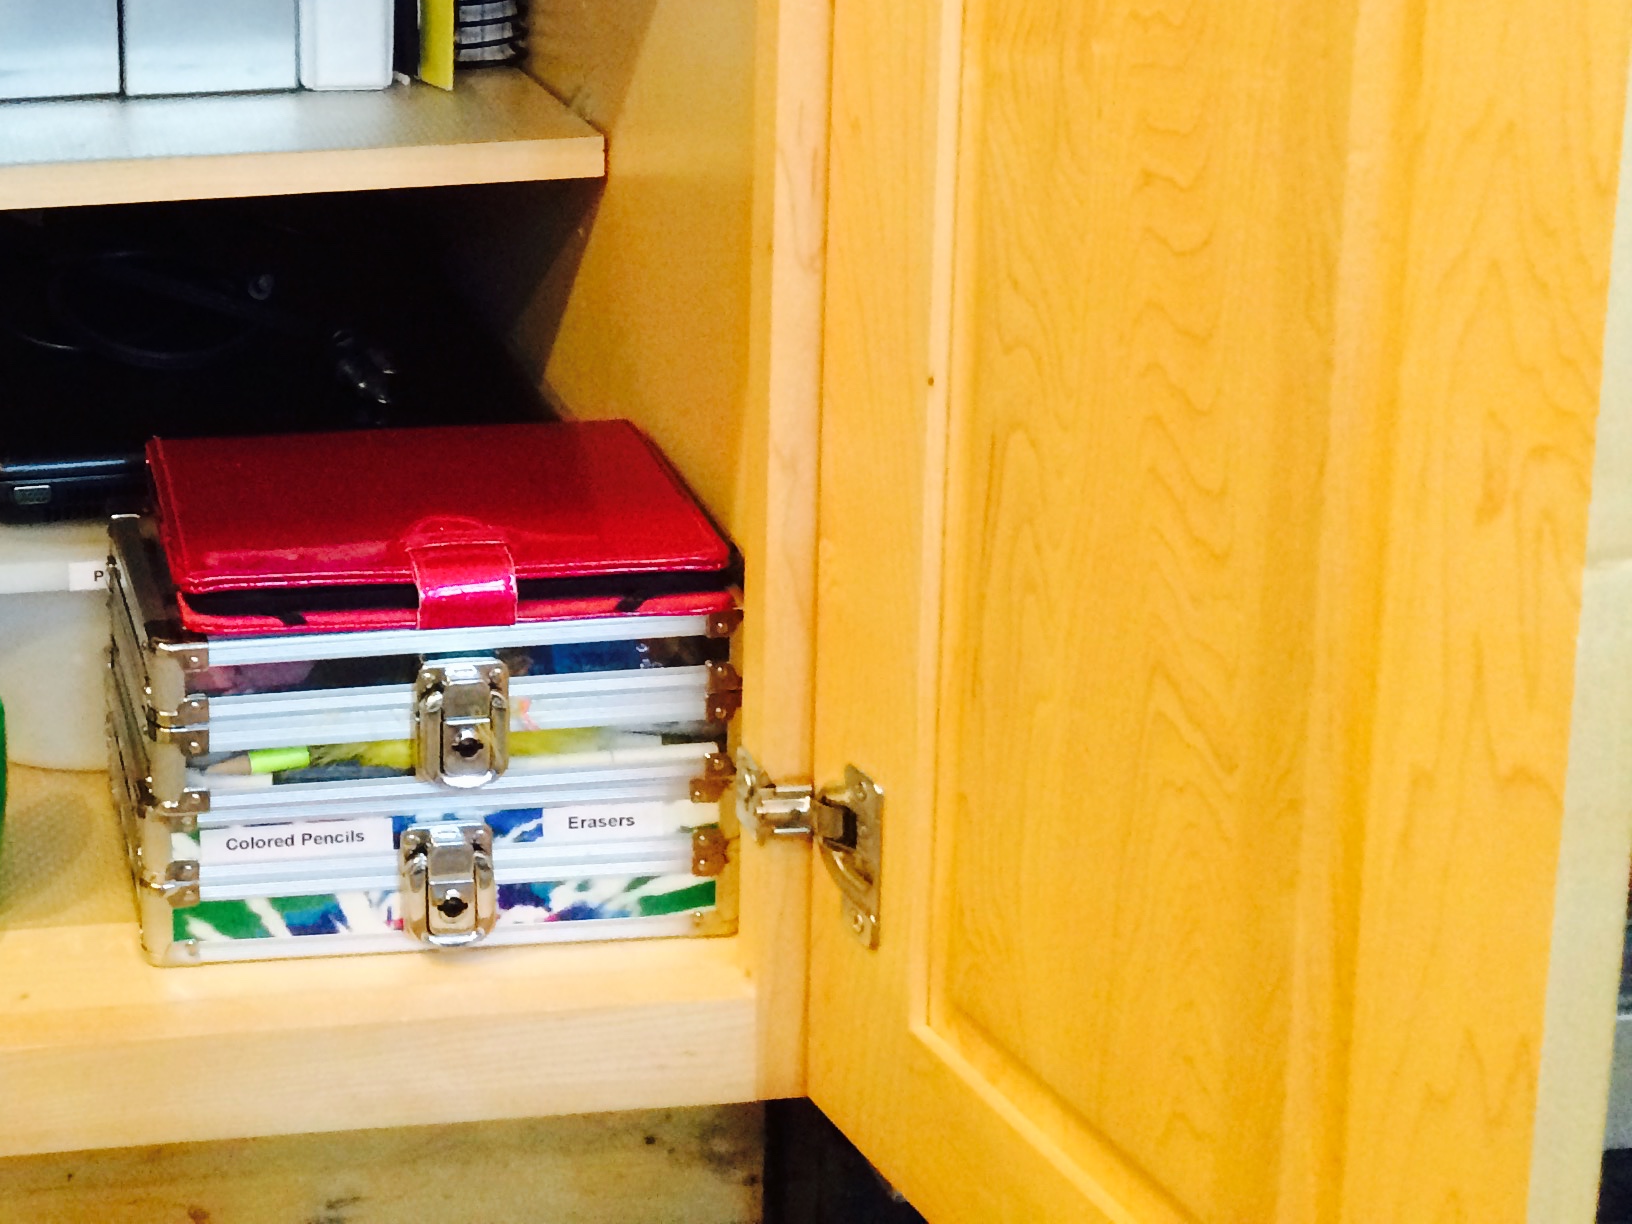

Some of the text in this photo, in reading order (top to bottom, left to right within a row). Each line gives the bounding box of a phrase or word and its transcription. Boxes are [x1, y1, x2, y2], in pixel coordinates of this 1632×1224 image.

[567, 814, 636, 831] Erasers
[225, 828, 365, 852] Colored Pencils
